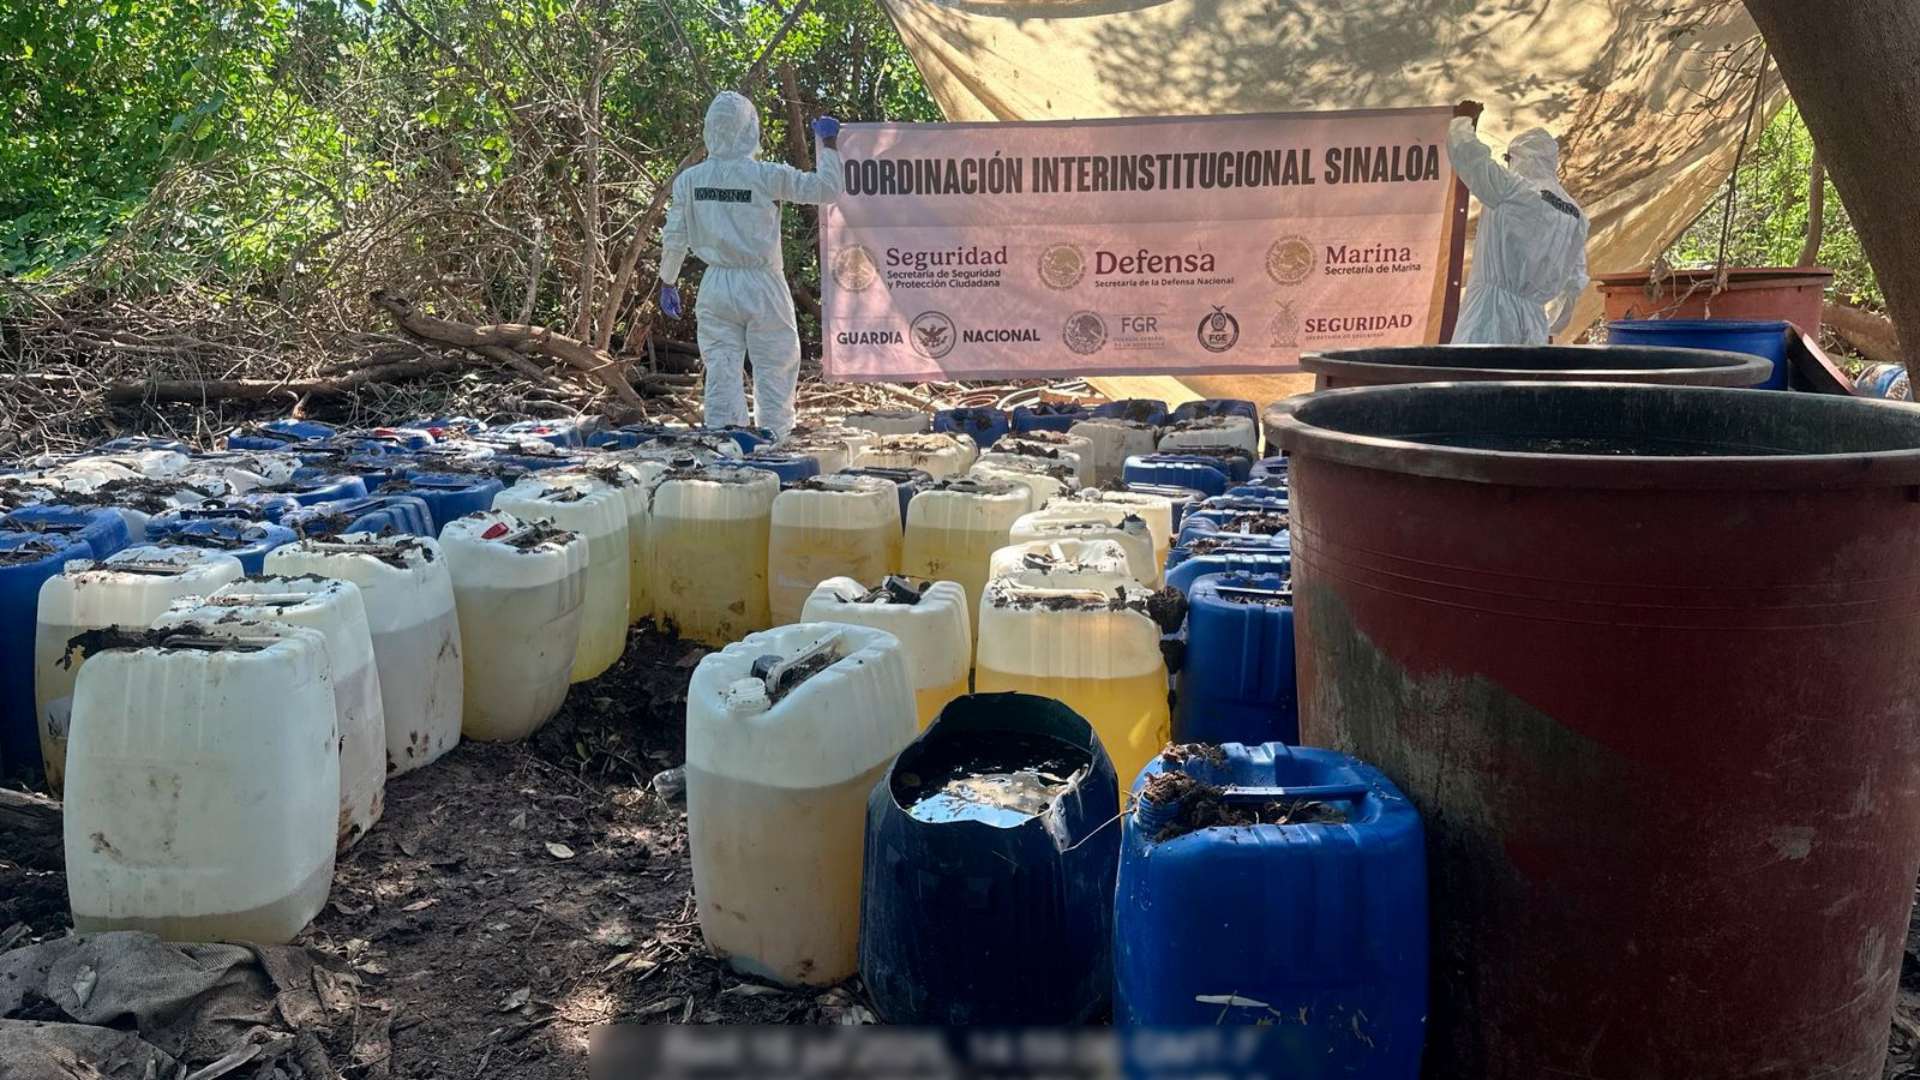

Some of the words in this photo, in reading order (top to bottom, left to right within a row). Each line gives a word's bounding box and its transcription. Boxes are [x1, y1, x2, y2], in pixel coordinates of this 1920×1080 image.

[844, 151, 1023, 196] OORDINACIÓN
[1032, 148, 1315, 193] INTERINSTITUCIONAL
[1325, 144, 1440, 185] SINALOA
[886, 246, 1008, 271] Seguridad
[1095, 249, 1215, 274] Defensa
[1326, 243, 1411, 265] Marina
[936, 269, 950, 278] de
[951, 268, 1001, 279] Seguridad
[1376, 264, 1389, 273] de
[1391, 263, 1421, 273] Marina
[887, 281, 894, 290] y
[895, 279, 947, 289] Protección
[948, 279, 1000, 288] Ciudadana
[1139, 279, 1150, 287] de
[1197, 277, 1234, 285] Nacional
[1121, 317, 1158, 333] FGR
[1305, 314, 1412, 333] SEGURIDAD
[836, 331, 904, 345] GUARDIA
[963, 329, 1040, 343] NACIONAL
